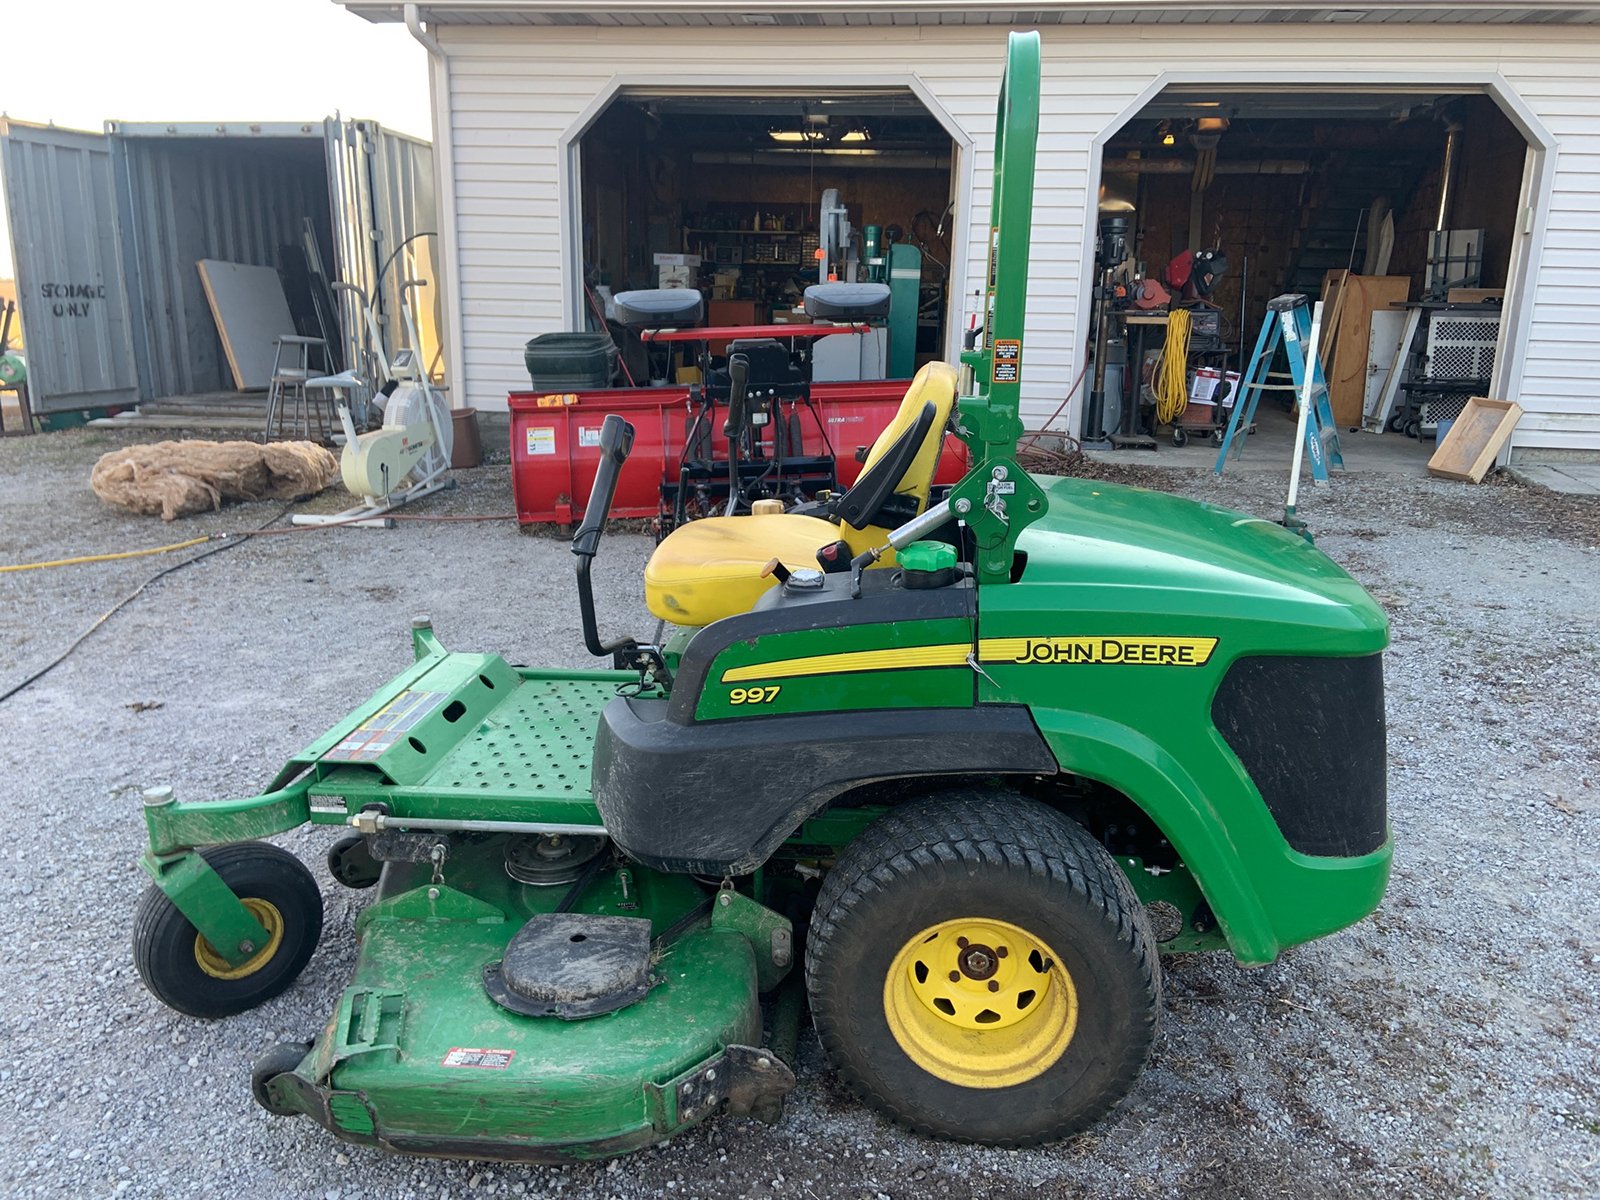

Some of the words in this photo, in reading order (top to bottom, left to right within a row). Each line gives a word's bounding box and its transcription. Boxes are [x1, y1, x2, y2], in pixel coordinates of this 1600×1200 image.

[53, 303, 89, 317] ONLY
[1016, 640, 1093, 660] JOHN
[1102, 640, 1194, 662] DEERE
[730, 686, 781, 704] 997
